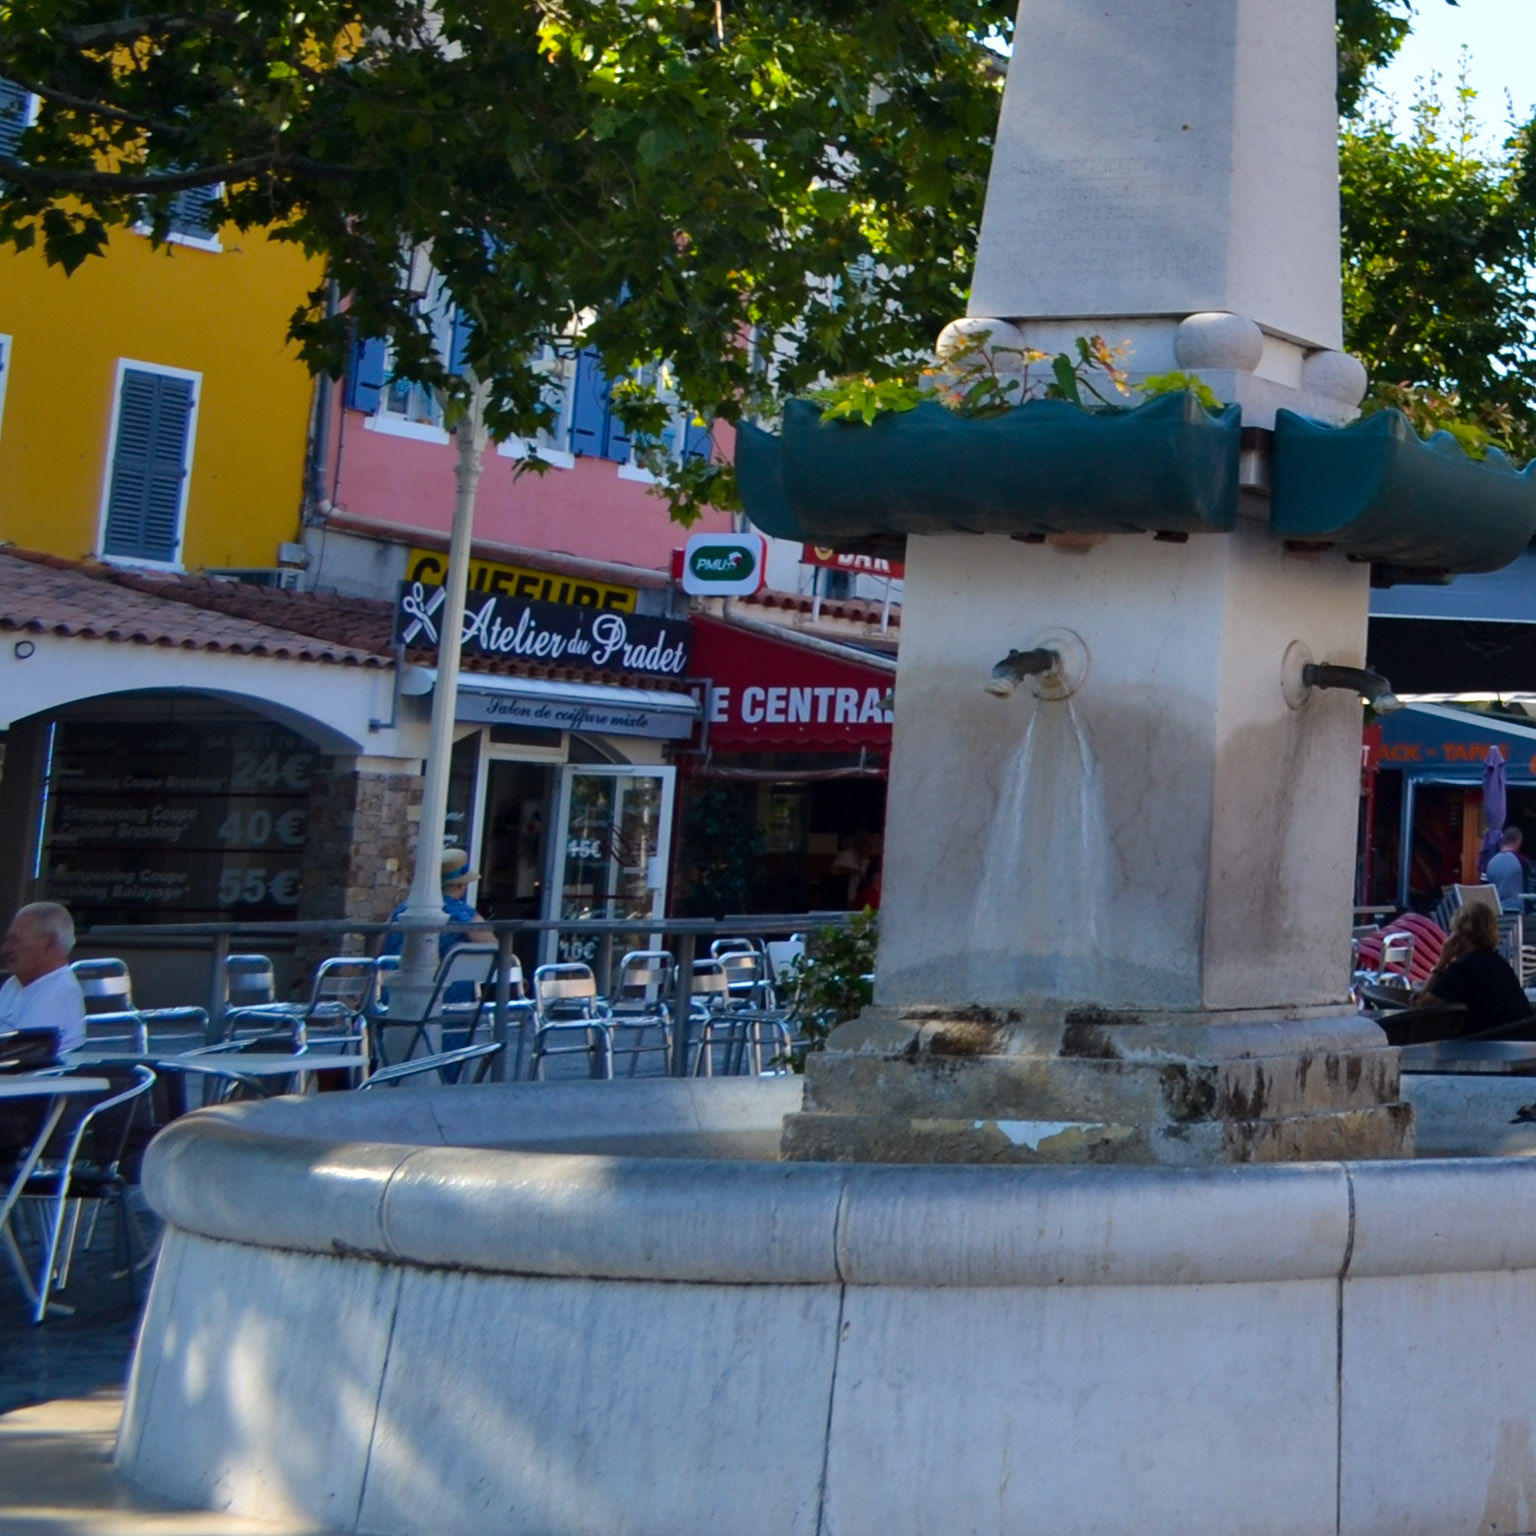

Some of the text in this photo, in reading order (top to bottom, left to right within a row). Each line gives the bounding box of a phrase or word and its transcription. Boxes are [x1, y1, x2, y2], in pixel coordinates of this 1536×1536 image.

[696, 558, 729, 571] PMU
[567, 627, 592, 655] du
[592, 613, 687, 673] Pradet
[486, 696, 649, 729] Salon de coiffure mixte
[231, 750, 313, 790] 24€
[218, 809, 308, 846] 40€
[217, 867, 301, 905] 55€
